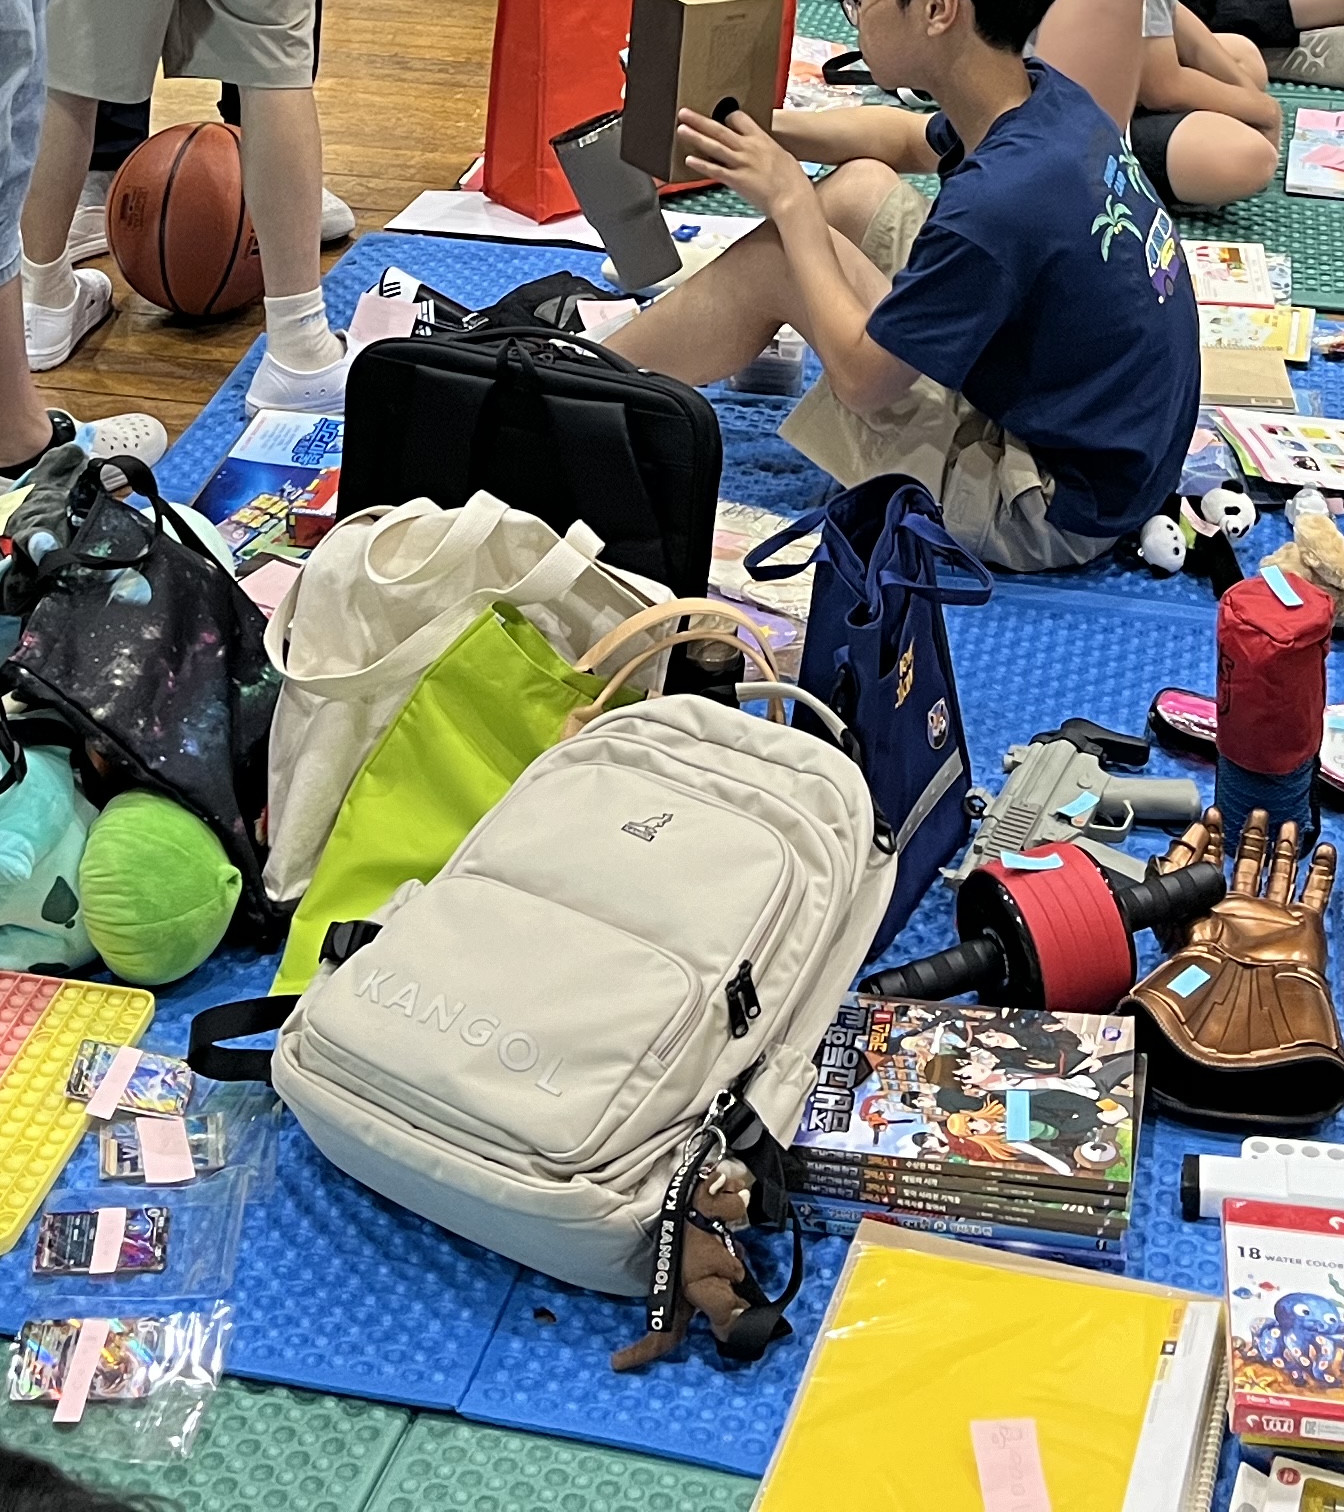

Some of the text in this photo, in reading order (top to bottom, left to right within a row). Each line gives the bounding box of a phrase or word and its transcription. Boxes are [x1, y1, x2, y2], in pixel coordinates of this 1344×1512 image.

[353, 966, 564, 1097] KANGOL
[652, 1219, 674, 1296] KANGOL
[1237, 1245, 1262, 1261] 18
[1264, 1254, 1302, 1267] WATER
